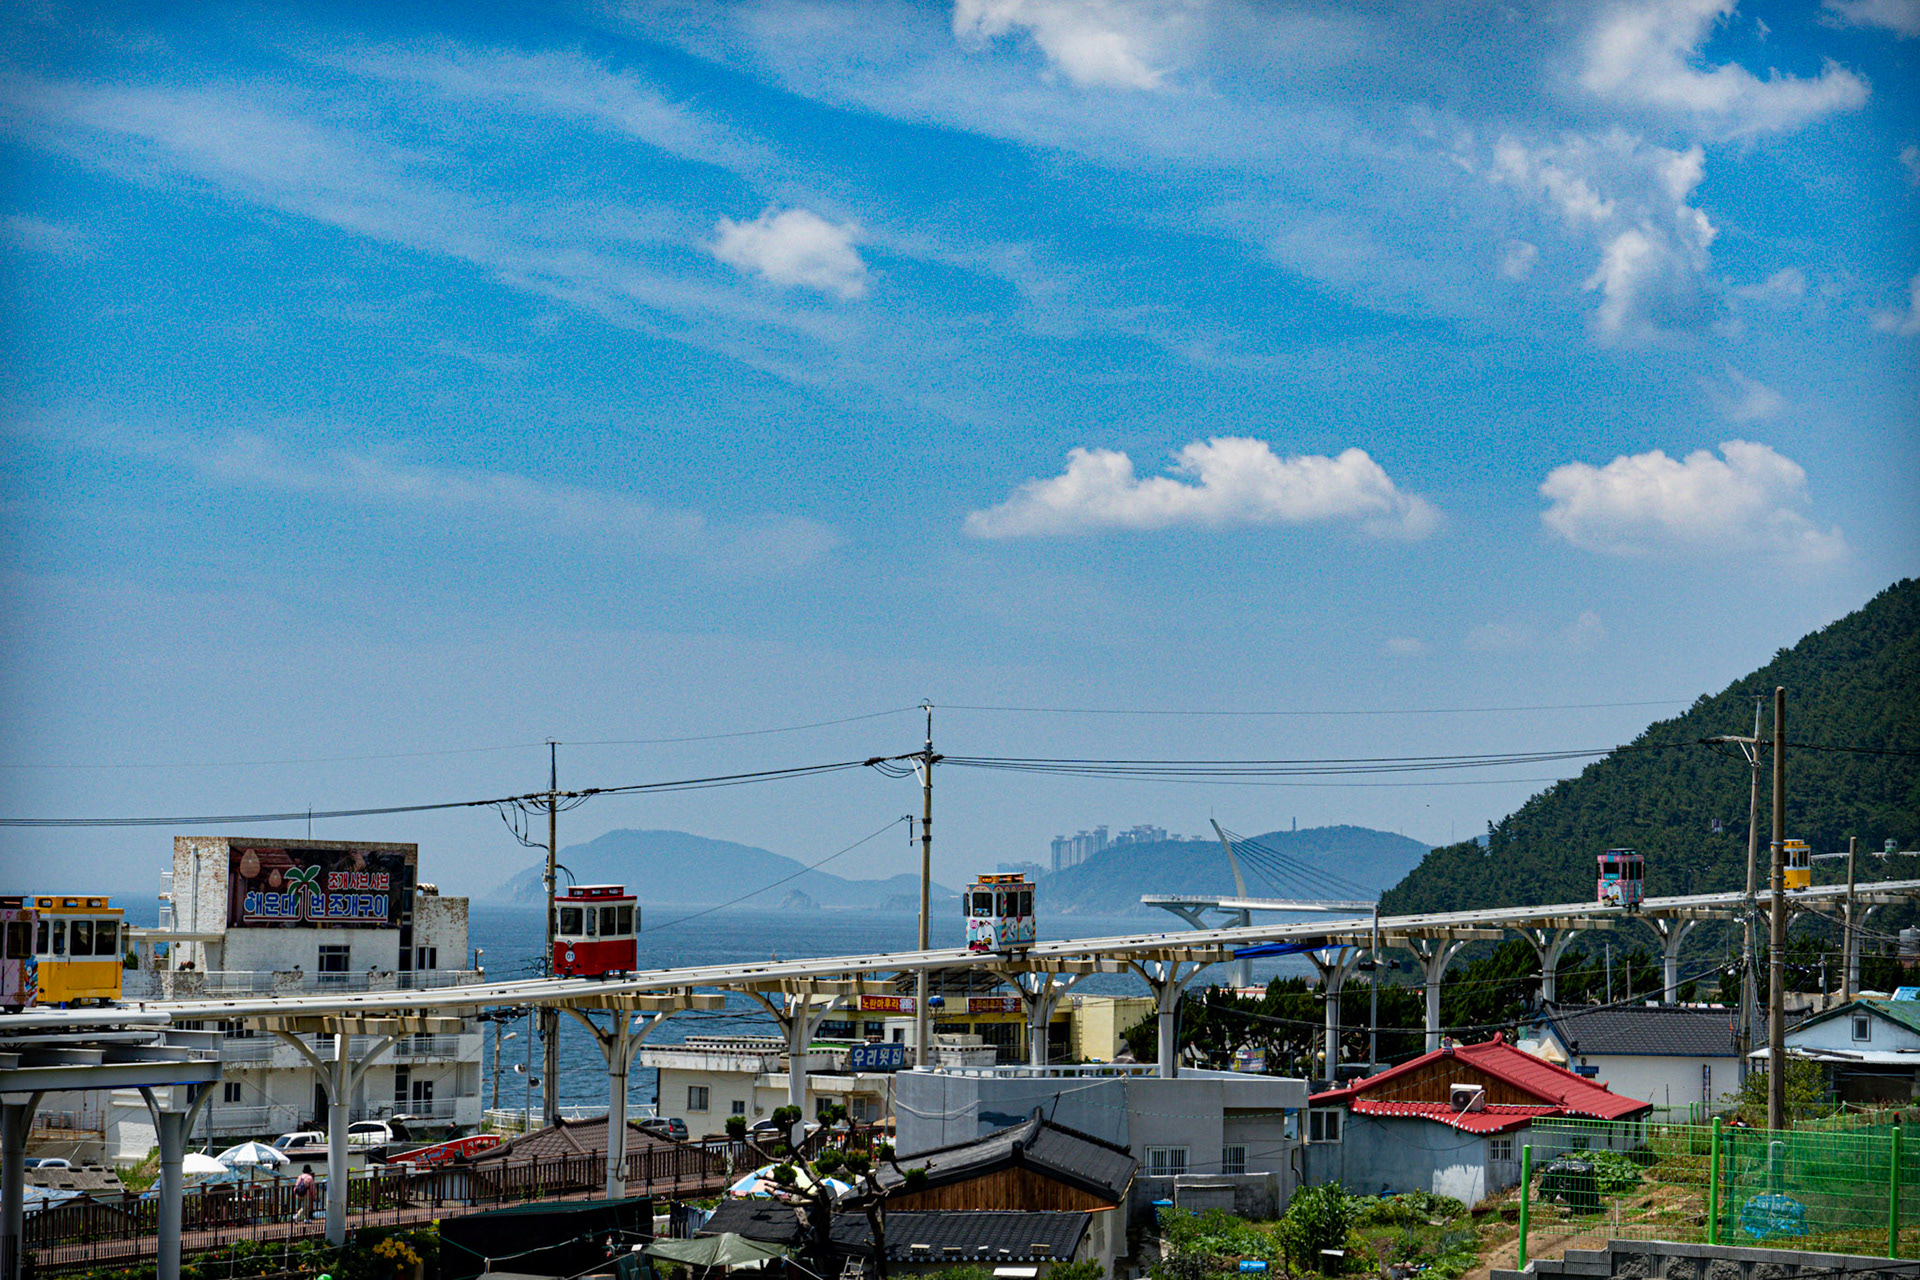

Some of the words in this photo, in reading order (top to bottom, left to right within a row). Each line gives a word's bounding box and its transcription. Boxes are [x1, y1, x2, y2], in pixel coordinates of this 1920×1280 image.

[328, 893, 388, 917] 조개구이
[566, 952, 574, 960] 01
[863, 998, 899, 1010] 노란마후라
